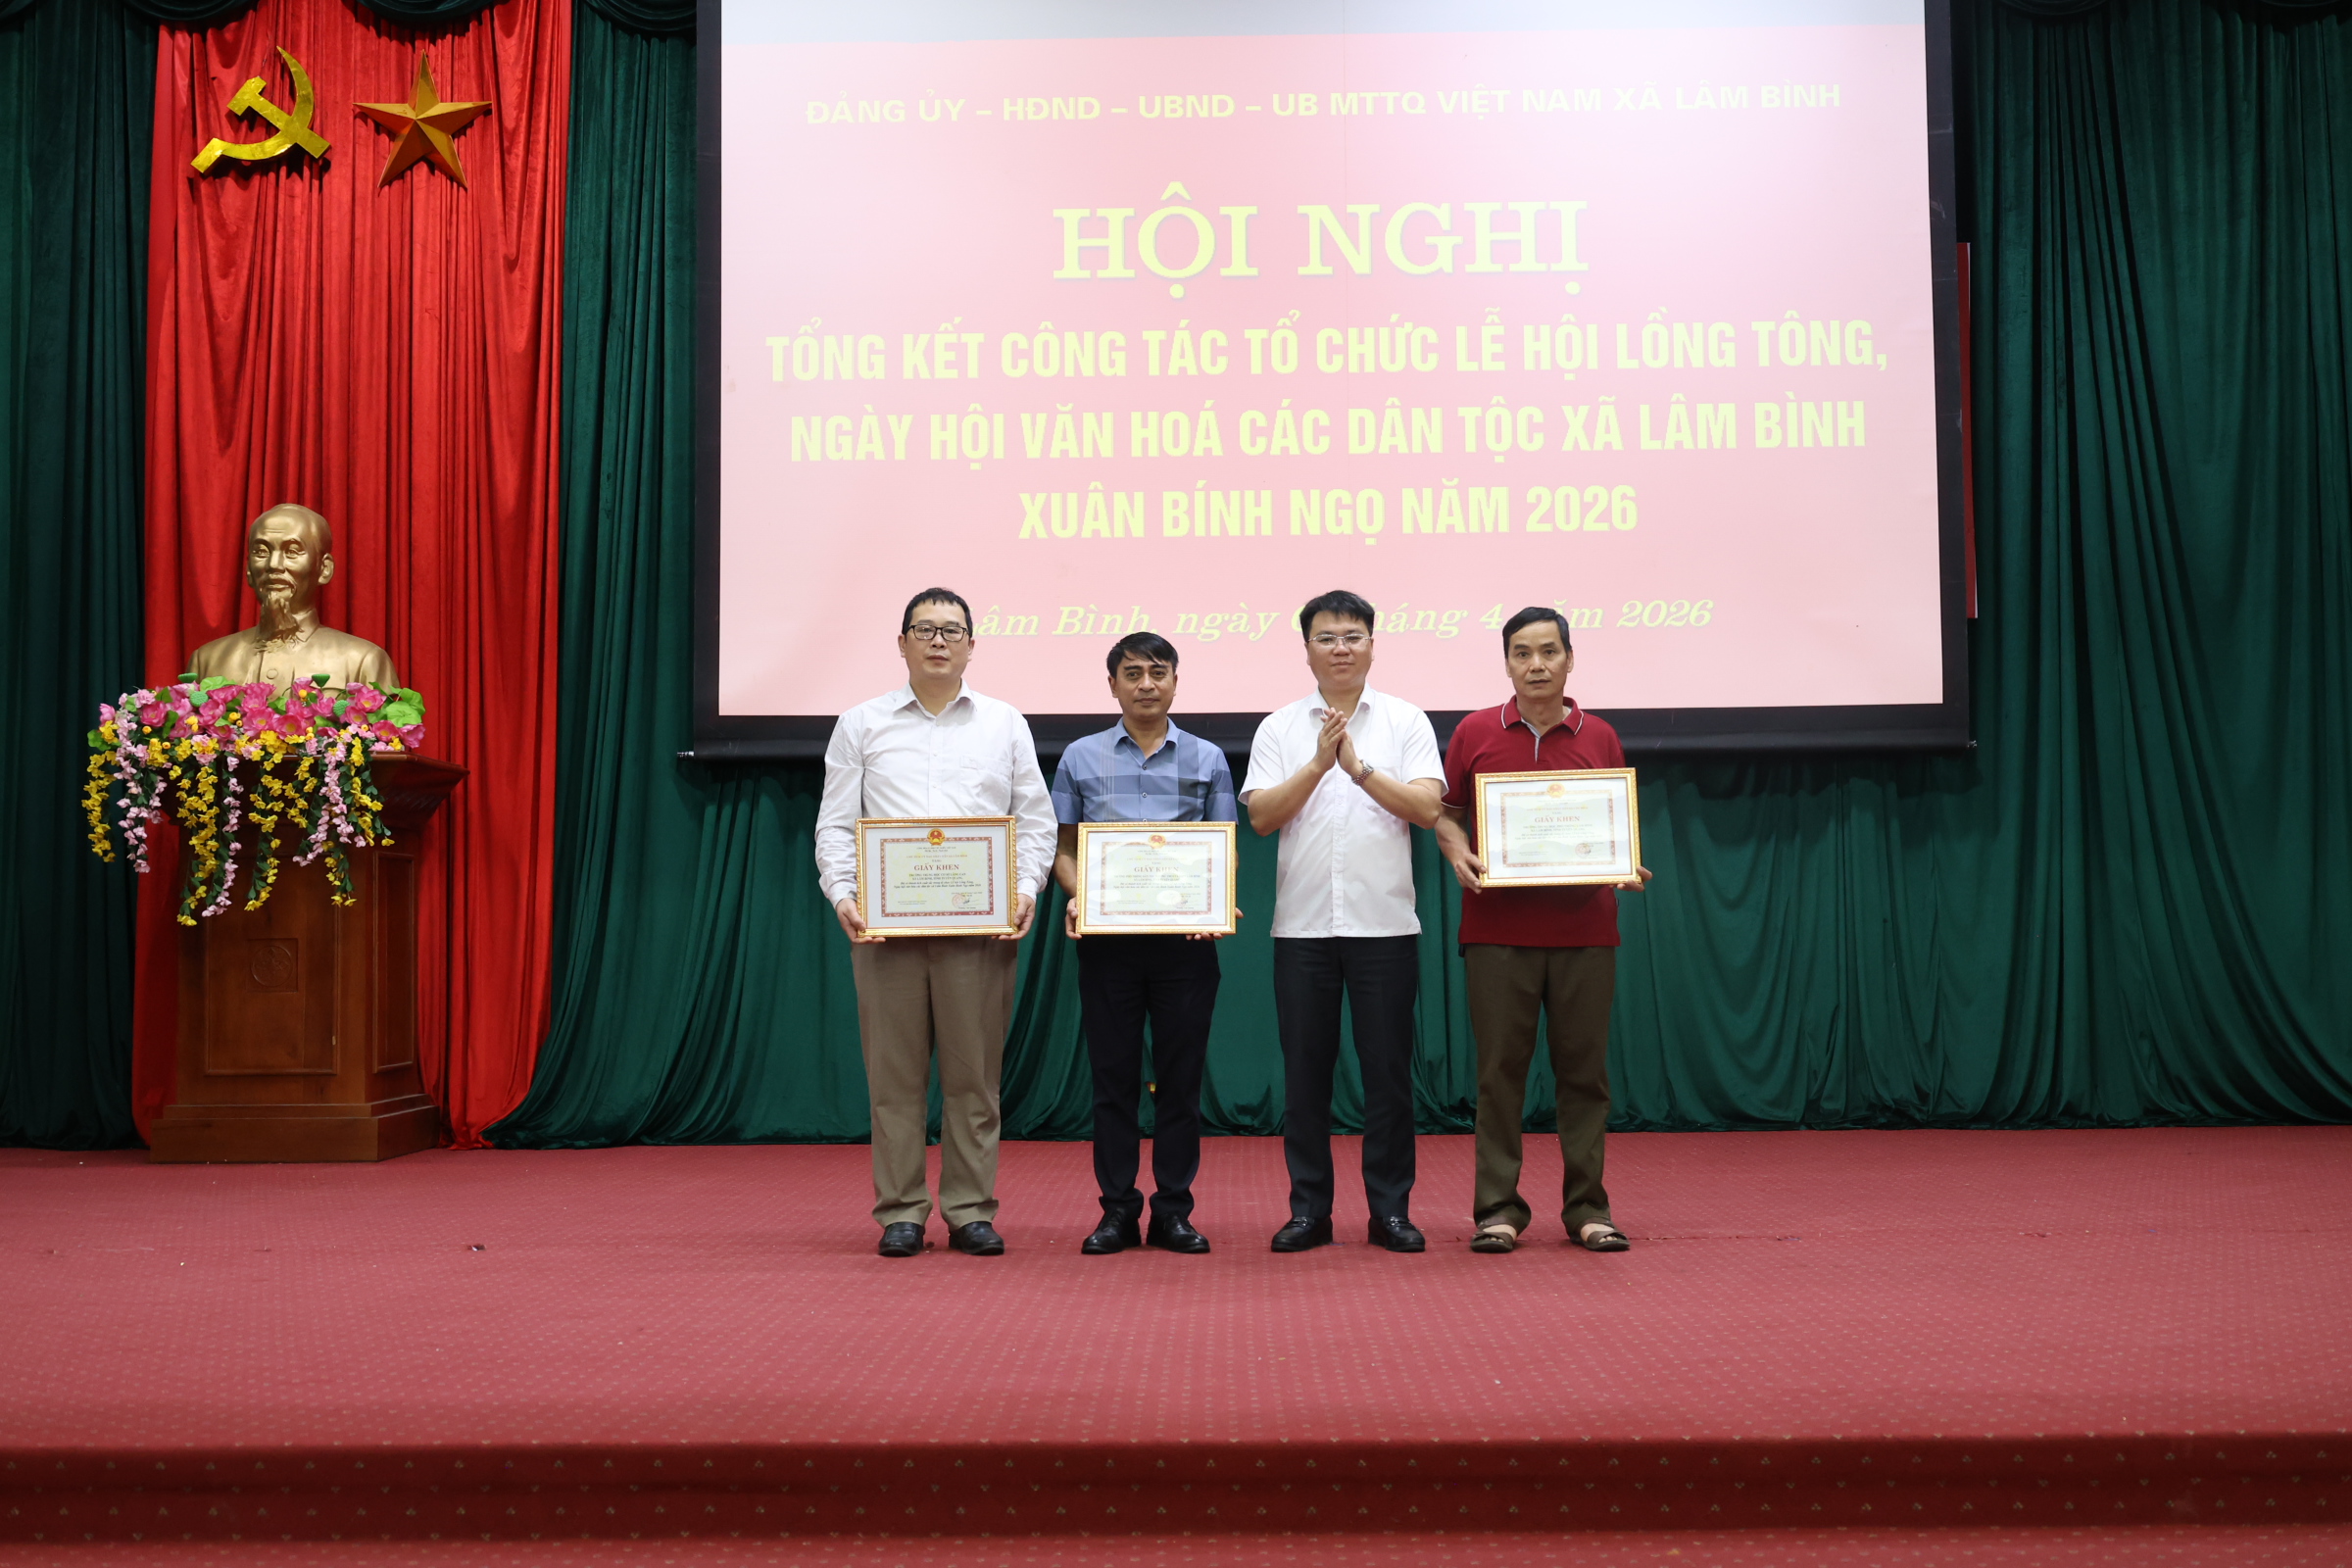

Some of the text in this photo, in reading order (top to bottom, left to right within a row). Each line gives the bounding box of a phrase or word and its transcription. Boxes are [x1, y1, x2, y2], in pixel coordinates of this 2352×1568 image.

[806, 89, 906, 124] ĐẢNG
[918, 87, 966, 123] ỦY
[1003, 96, 1102, 122] HĐND
[1138, 93, 1237, 119] UBND
[1272, 91, 1320, 118] UB
[1330, 90, 1428, 116] MTTQ
[1437, 82, 1511, 121] VIỆT
[1522, 88, 1601, 112] NAM
[1614, 80, 1663, 111] XÃ
[1676, 78, 1749, 110] LÂM
[1761, 78, 1841, 109] BÌNH
[1053, 180, 1590, 299] HỘI NGHỊ
[765, 306, 1888, 382] TỔNG KẾT CÔNG TÁC TỔ CHỨC LỄ HỘI LỒNG TÔNG,
[791, 390, 1867, 470] NGÀY HỘI VĂN HOÁ CÁC DÂN TỘC XÃ LÂM BÌNH
[1018, 477, 1640, 546] XUÂN BÍNH NGỌ NĂM 2026
[971, 605, 1041, 636] âm
[1172, 602, 1282, 642] ngày
[1371, 602, 1470, 639] háng
[1479, 603, 1505, 630] 4
[1616, 599, 1716, 629] 2026
[913, 862, 934, 871] GIẤY
